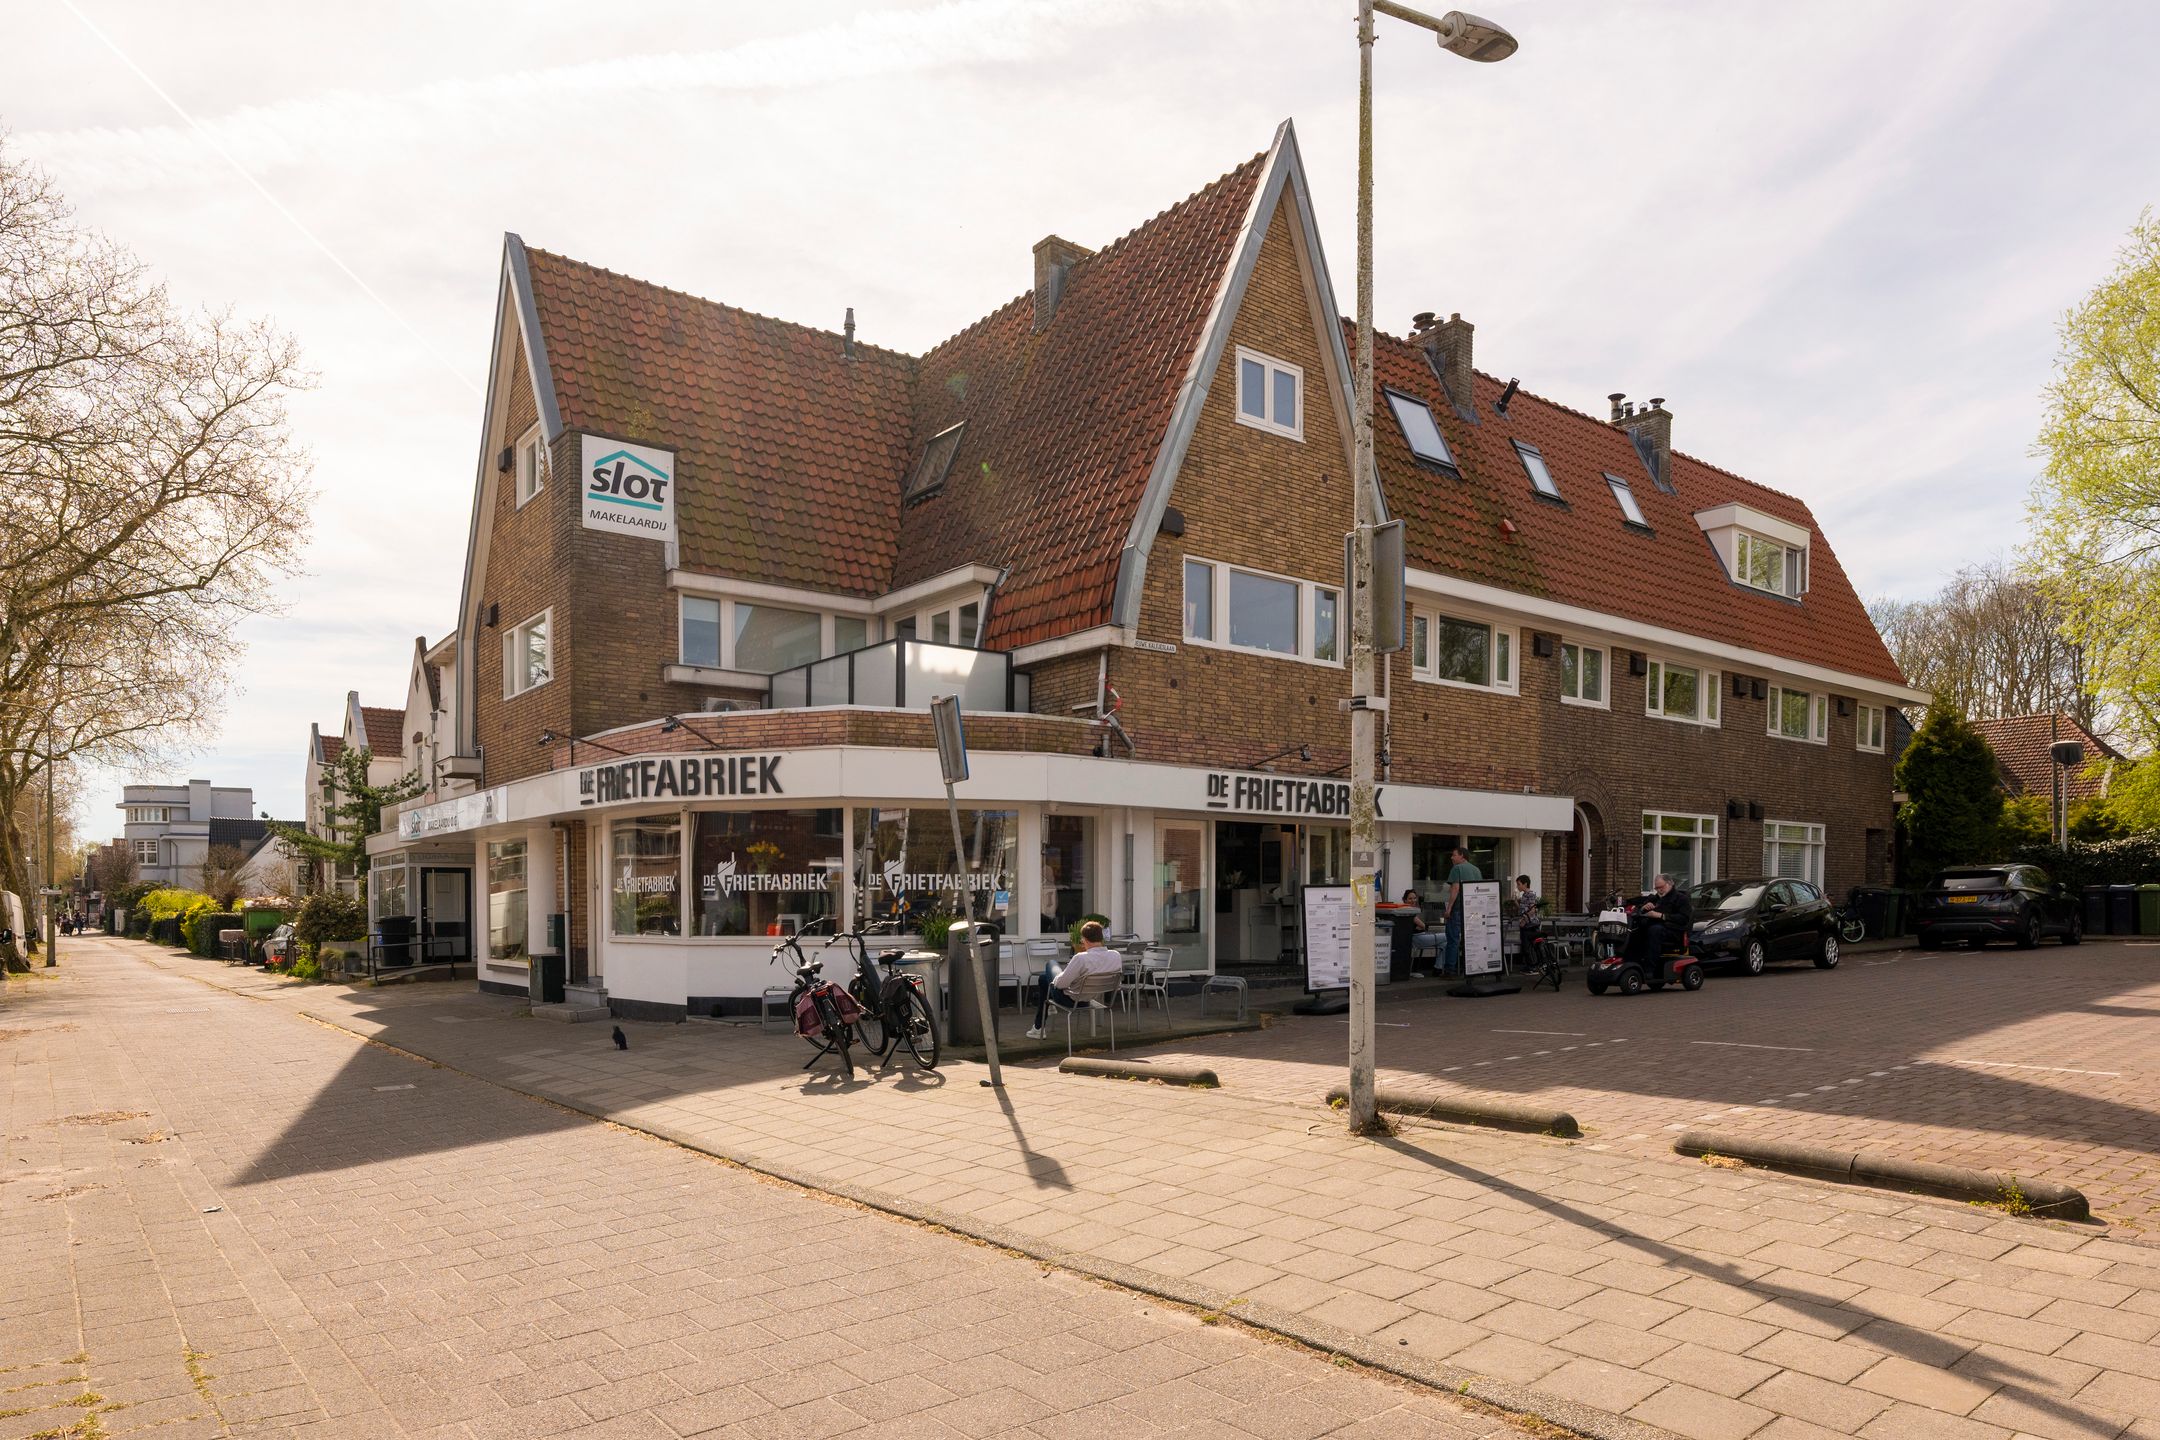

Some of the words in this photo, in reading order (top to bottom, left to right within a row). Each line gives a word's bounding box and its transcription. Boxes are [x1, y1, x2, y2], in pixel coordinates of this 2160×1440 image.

[590, 461, 668, 504] slot
[589, 509, 667, 531] MAKELAARDIJ
[580, 771, 595, 794] DE
[596, 755, 783, 803] FRIETFABRIEK
[1208, 773, 1229, 798] DE
[1235, 776, 1383, 817] FRIETFABRK
[617, 877, 624, 889] DE
[703, 875, 716, 887] DE
[868, 873, 882, 886] DE
